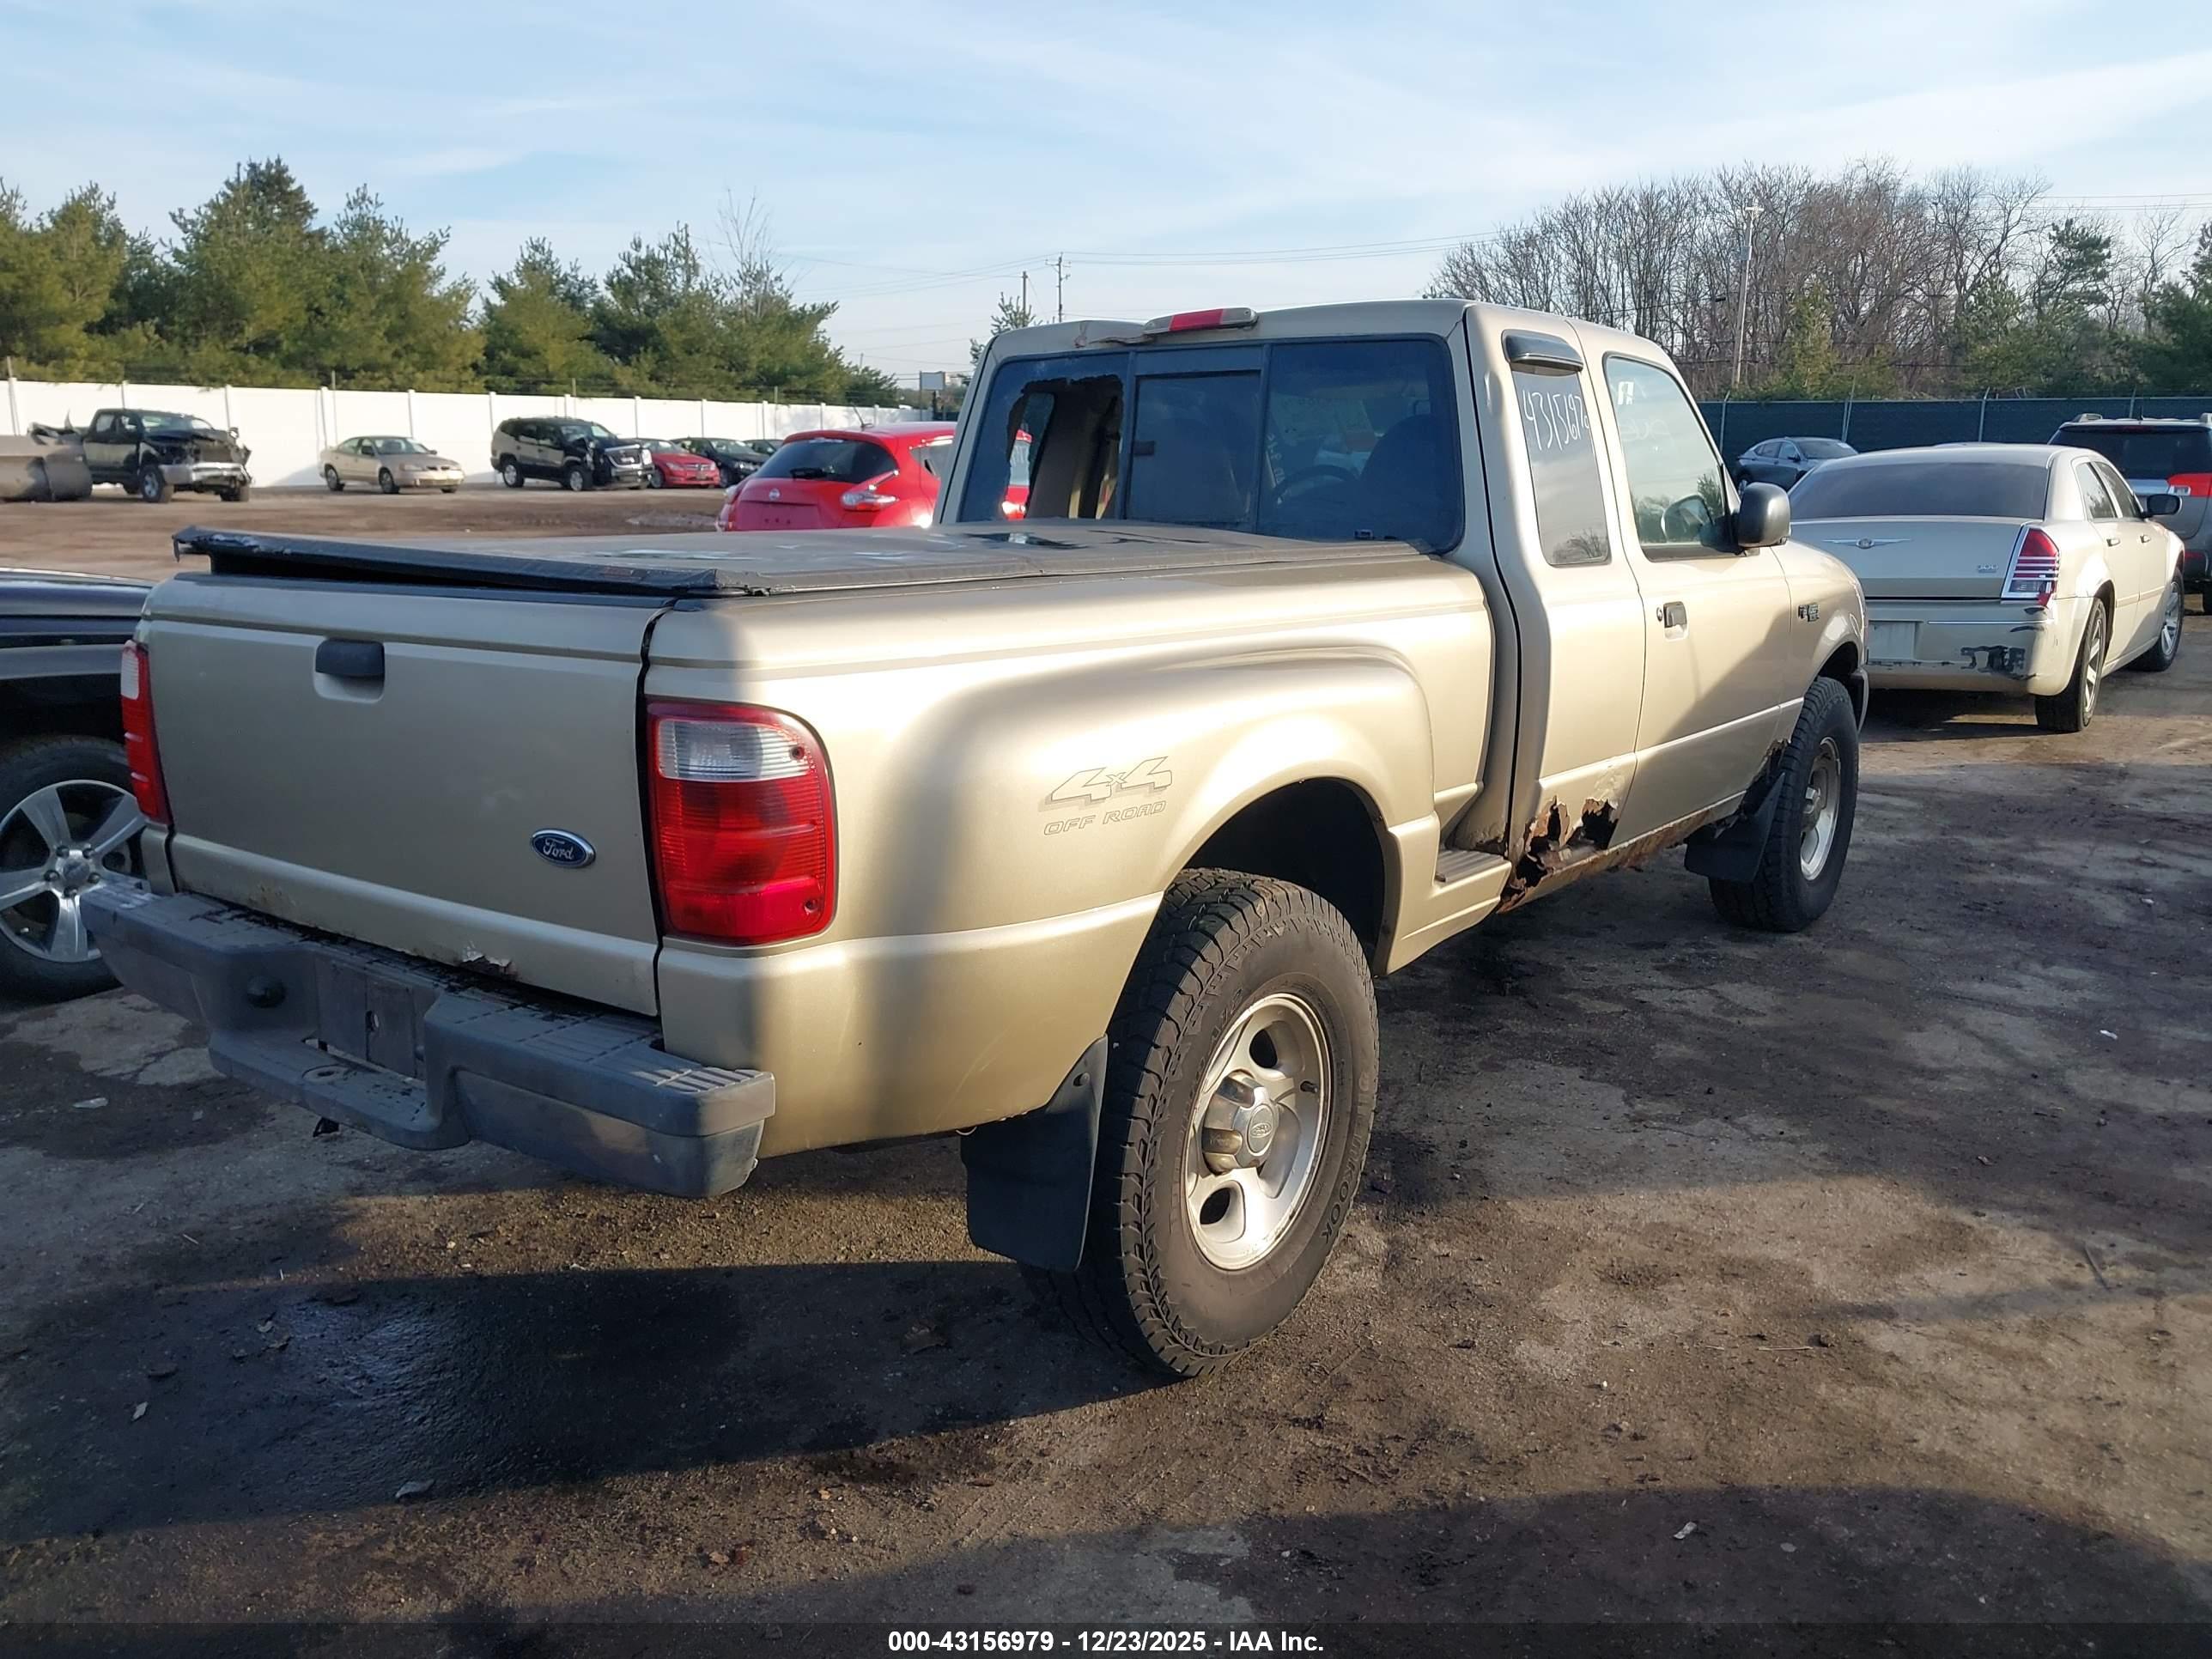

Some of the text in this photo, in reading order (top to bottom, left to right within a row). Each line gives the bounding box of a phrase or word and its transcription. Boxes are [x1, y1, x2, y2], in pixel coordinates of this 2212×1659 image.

[1043, 800, 1166, 836] OFF ROAD
[543, 837, 574, 860] Ford
